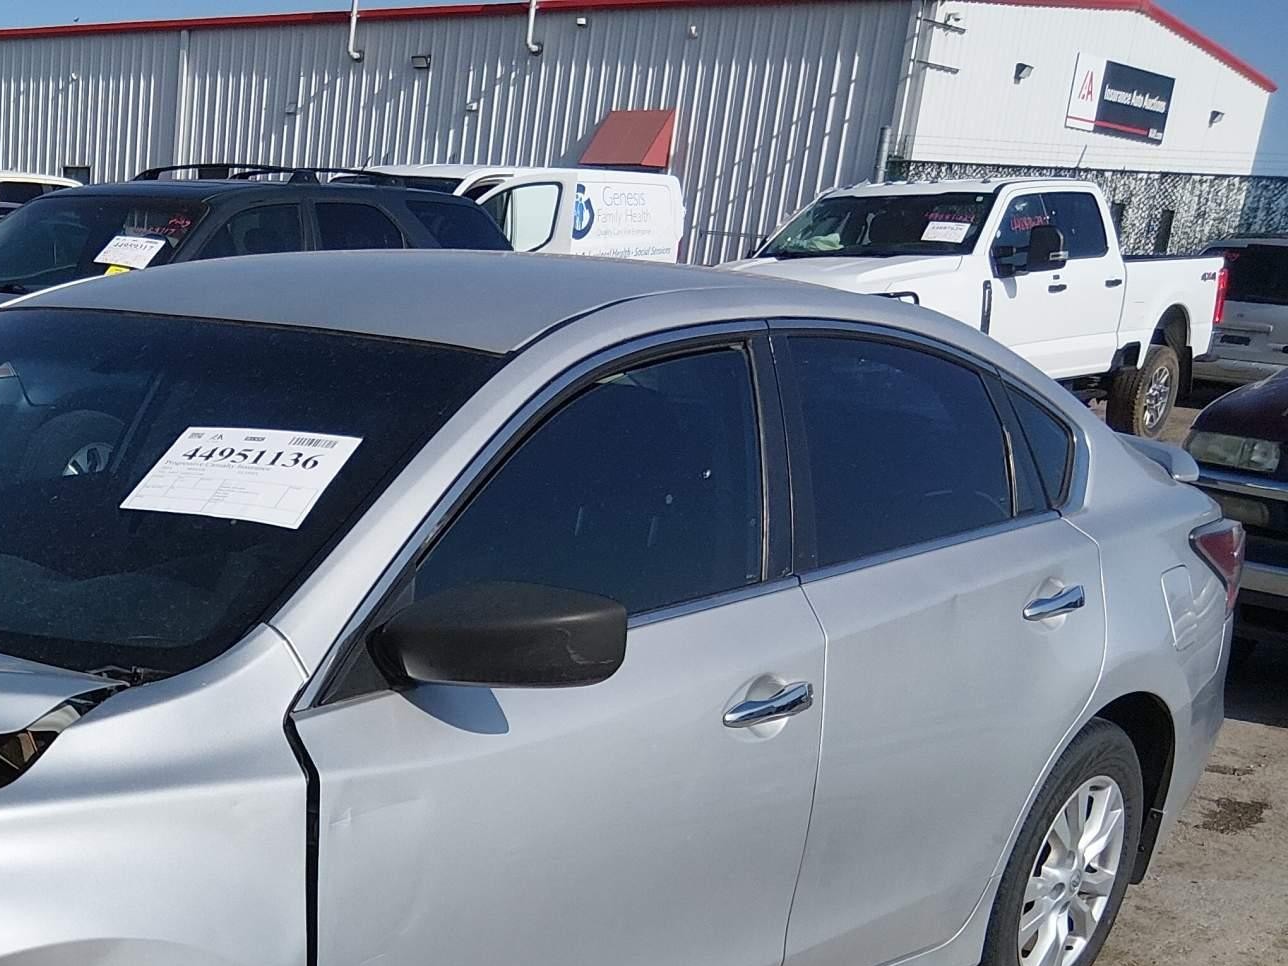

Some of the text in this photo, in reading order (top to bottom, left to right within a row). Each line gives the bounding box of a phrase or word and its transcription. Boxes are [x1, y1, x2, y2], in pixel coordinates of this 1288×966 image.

[1103, 83, 1167, 113] Insurance Auto Auctions
[602, 185, 646, 207] Genesis
[597, 208, 651, 225] Family Health
[181, 445, 325, 471] 44951136
